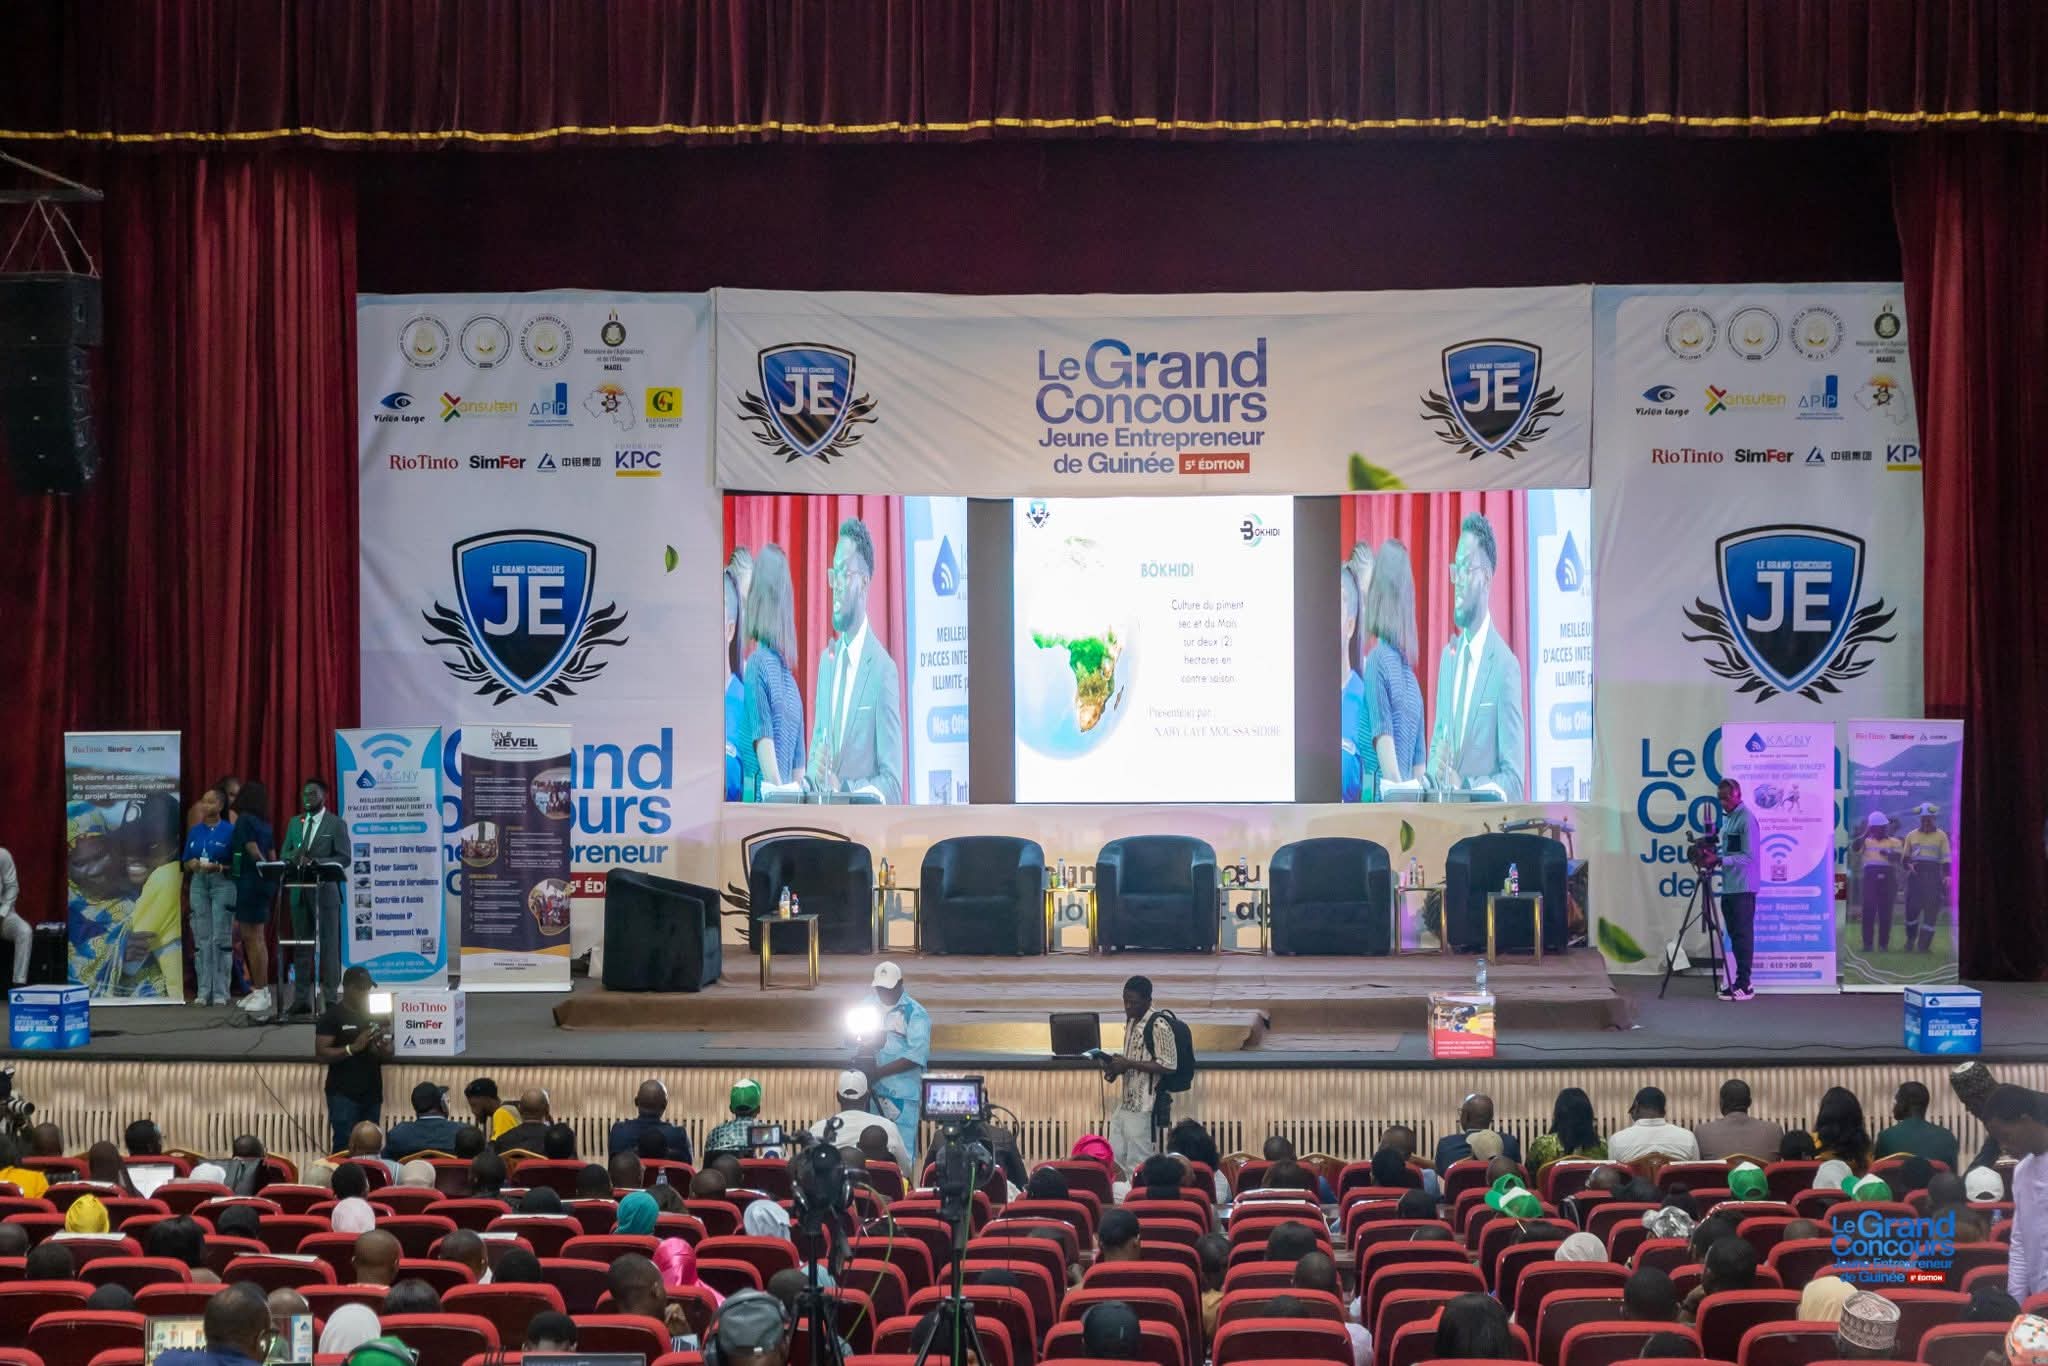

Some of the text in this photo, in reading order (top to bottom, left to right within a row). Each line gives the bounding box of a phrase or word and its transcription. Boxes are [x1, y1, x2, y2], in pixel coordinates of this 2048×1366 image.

[1039, 337, 1268, 389] Le Grand
[780, 374, 836, 416] JE
[1463, 370, 1521, 413] JE
[1036, 383, 1268, 424] Concours
[1636, 407, 1663, 415] Vision
[1039, 427, 1265, 451] Jeune Entrepreneur
[469, 455, 527, 470] SimFer
[615, 450, 662, 468] KPC
[1053, 451, 1245, 474] de Guinée ÉDITION
[1735, 449, 1794, 463] SimFer
[1887, 445, 1921, 463] KP
[484, 575, 566, 636] JE
[1171, 600, 1244, 611] Culture du piment
[1747, 571, 1833, 632] JE
[1193, 619, 1202, 628] et
[1204, 618, 1215, 628] du
[1560, 622, 1592, 638] MEILLEU
[937, 626, 967, 642] MEILLEU
[1197, 637, 1217, 647] deux
[952, 650, 968, 665] INTE
[1184, 655, 1232, 665] hectares en
[1575, 646, 1592, 661] INTE
[1641, 738, 1696, 778] Le
[85, 793, 107, 801] projet
[957, 780, 968, 802] Int
[1580, 777, 1591, 801] Int
[374, 864, 392, 872] Cyber
[1658, 872, 1696, 897] de
[405, 1019, 443, 1029] SimFer
